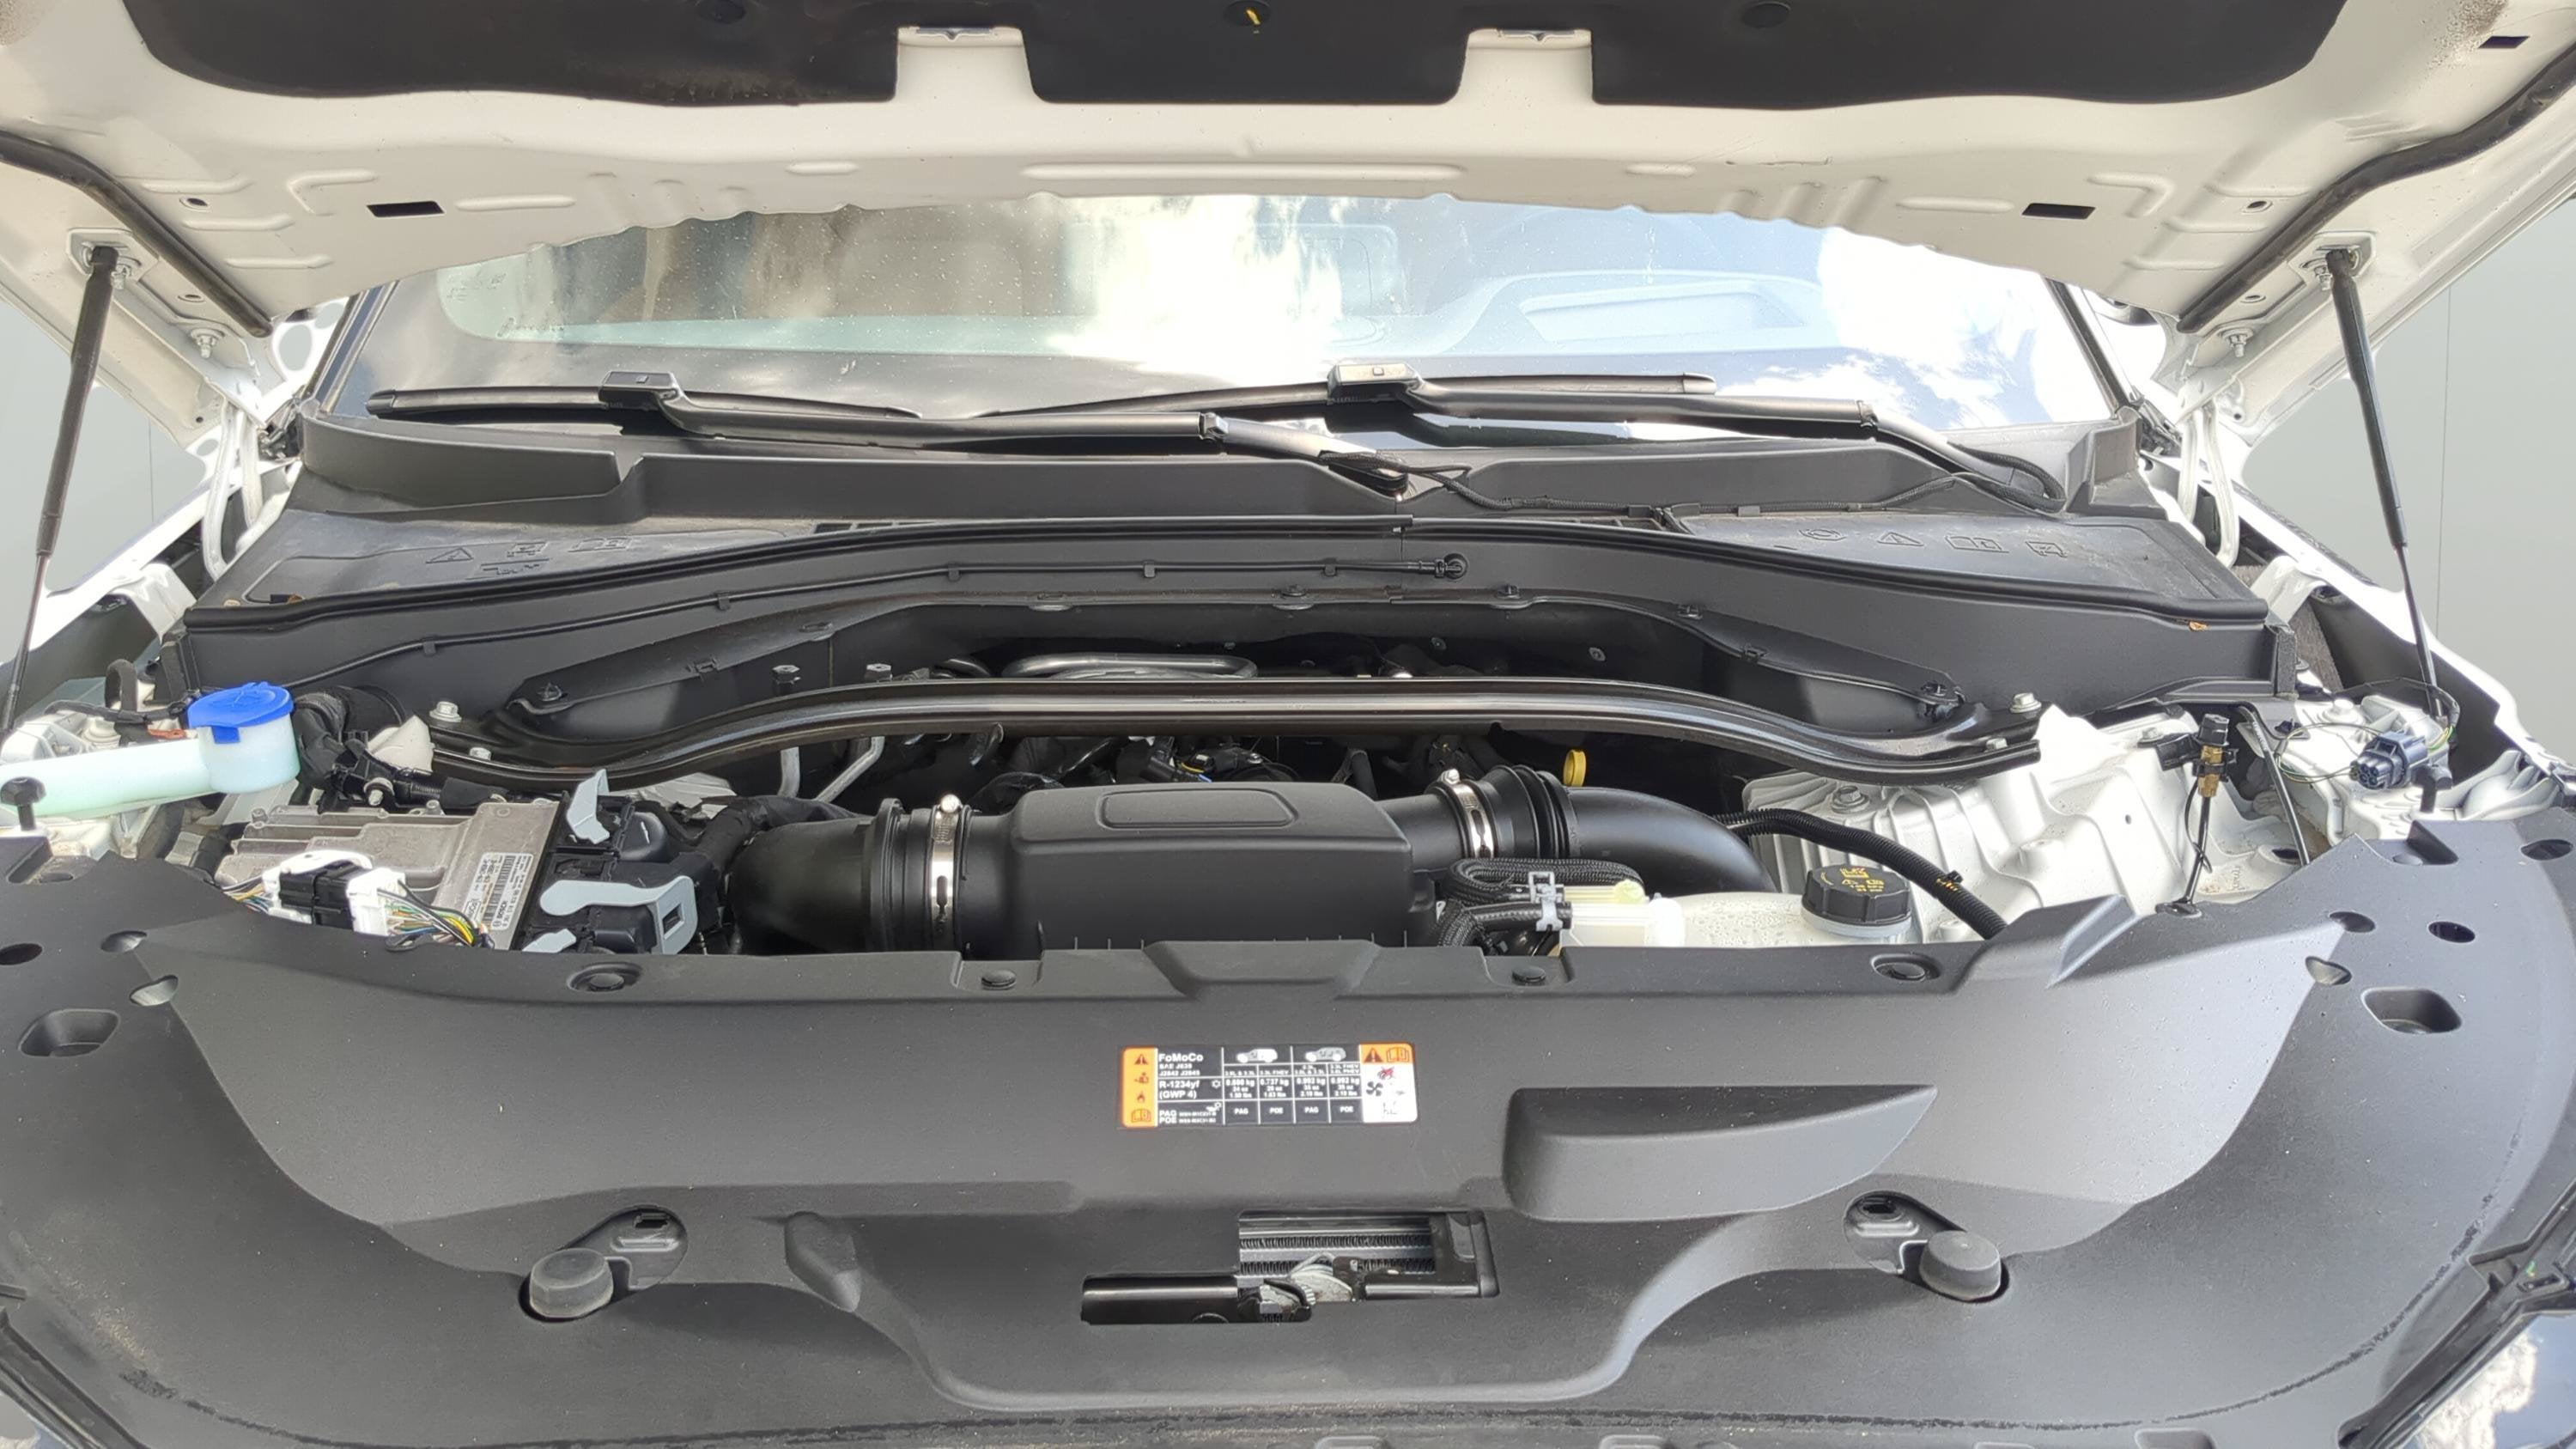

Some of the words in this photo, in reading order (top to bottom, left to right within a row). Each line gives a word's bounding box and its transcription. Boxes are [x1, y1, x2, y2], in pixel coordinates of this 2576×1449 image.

[497, 901, 509, 918] BOSCH
[1158, 1052, 1204, 1062] FoMoCo
[1159, 1080, 1200, 1090] R-1234yf
[1245, 1079, 1255, 1087] kg
[1279, 1078, 1289, 1087] kg
[1159, 1090, 1186, 1099] (GWP
[1187, 1090, 1197, 1099] 4)
